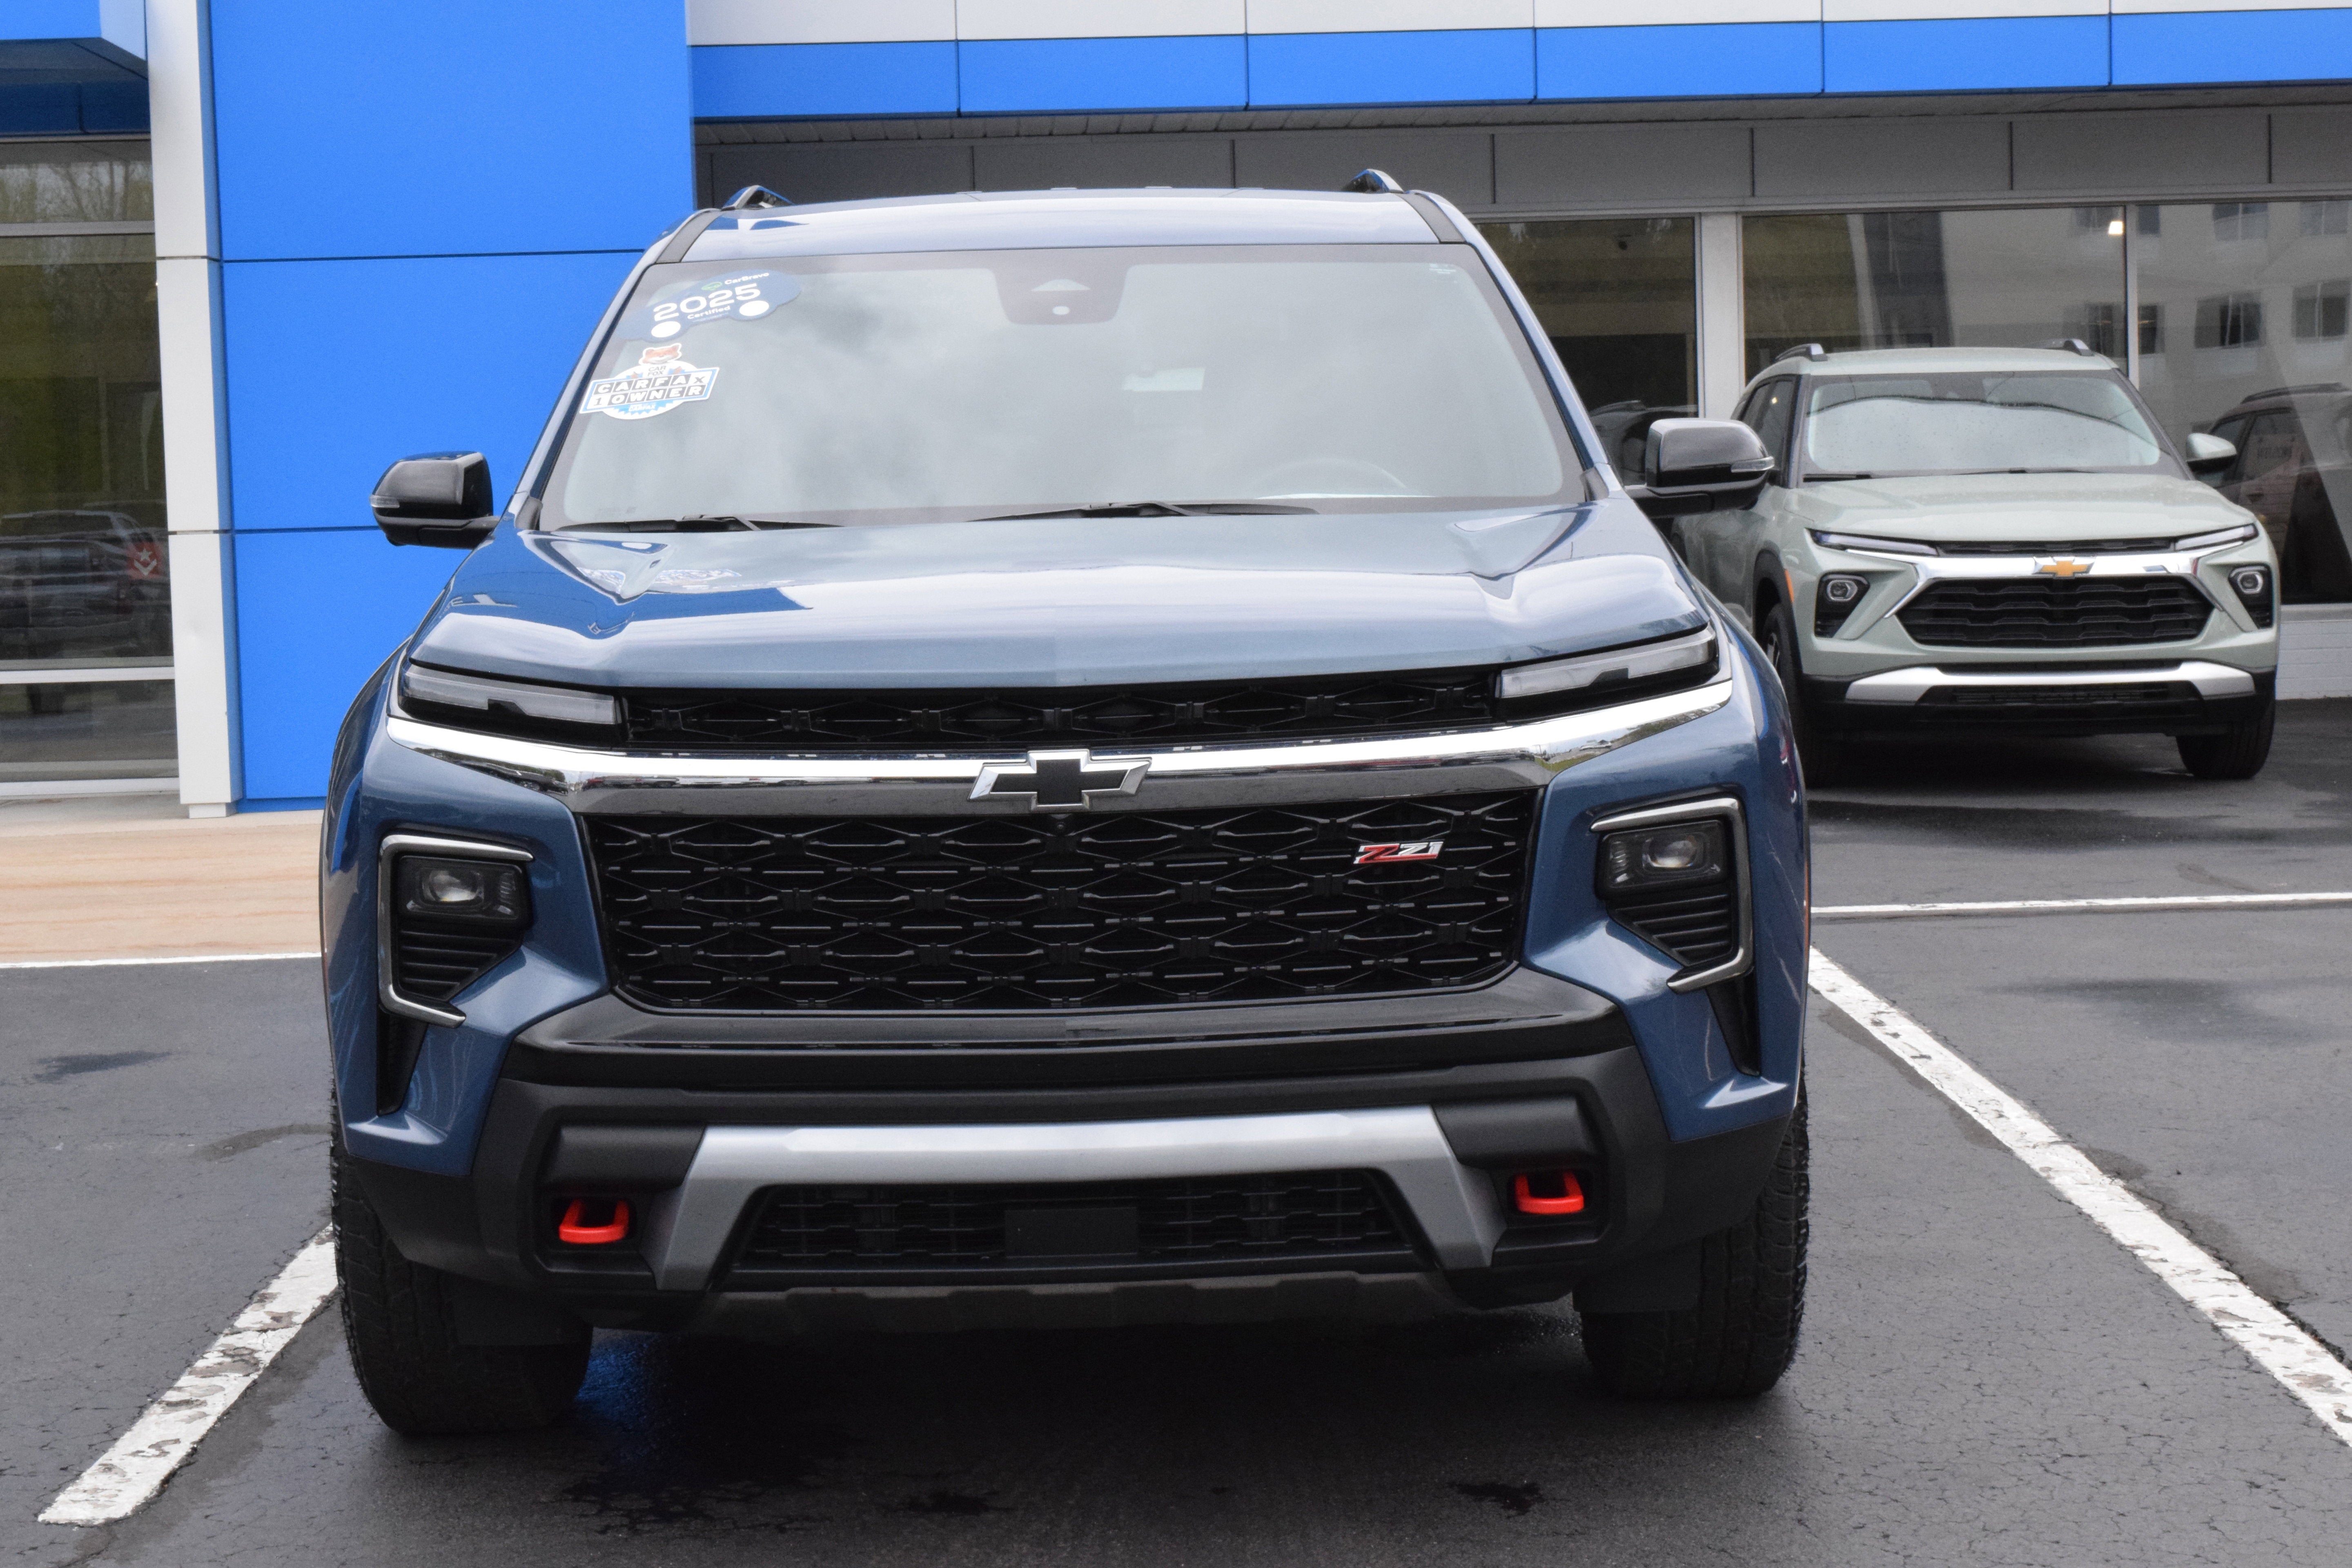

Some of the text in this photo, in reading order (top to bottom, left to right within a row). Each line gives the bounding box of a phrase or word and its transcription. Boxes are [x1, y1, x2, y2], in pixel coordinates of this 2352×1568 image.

[724, 272, 769, 285] CarBravo
[653, 283, 760, 321] 2025
[687, 305, 731, 319] Certified
[597, 375, 706, 393] CARFAX
[593, 386, 703, 406] 1 OWNER
[1353, 841, 1444, 864] Z71
